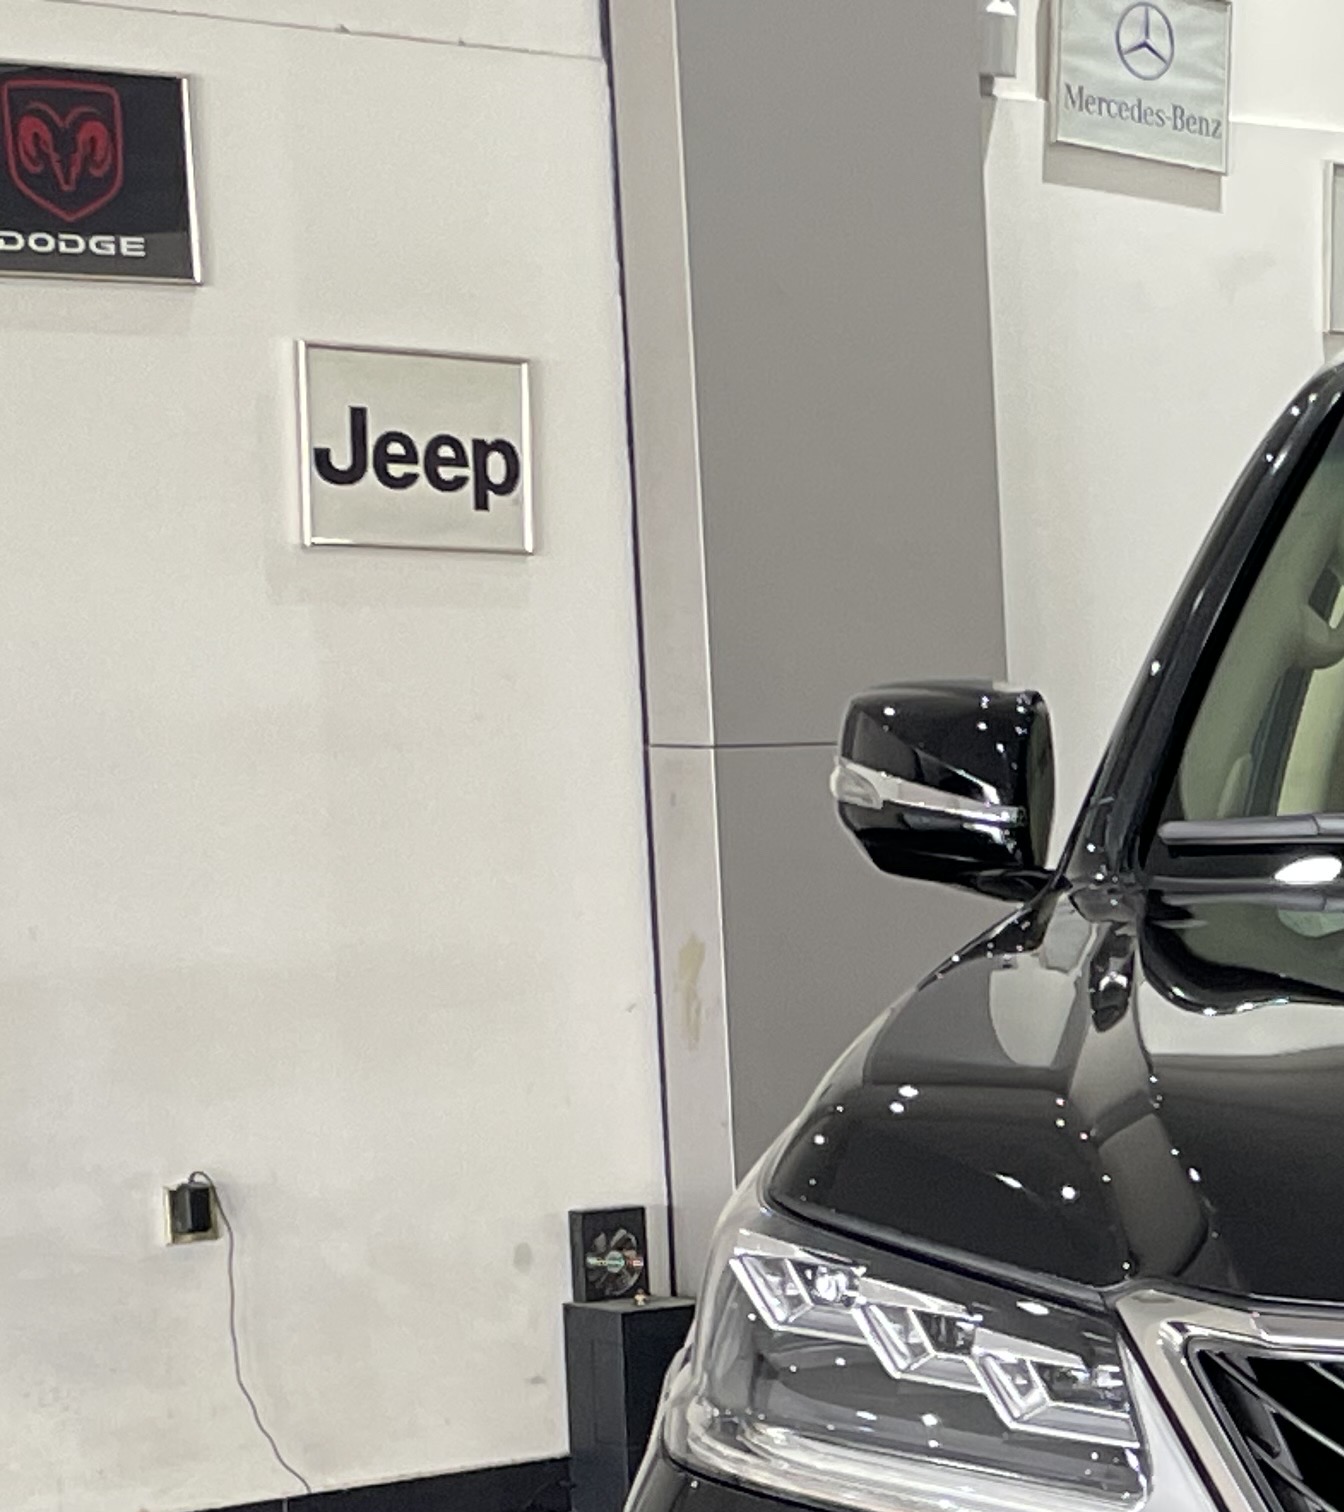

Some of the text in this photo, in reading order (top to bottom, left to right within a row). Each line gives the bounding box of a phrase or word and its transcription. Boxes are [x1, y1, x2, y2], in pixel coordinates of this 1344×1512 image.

[1064, 82, 1222, 139] Mercedes-Benz
[0, 231, 146, 257] DODGE
[313, 406, 520, 512] Jeep
